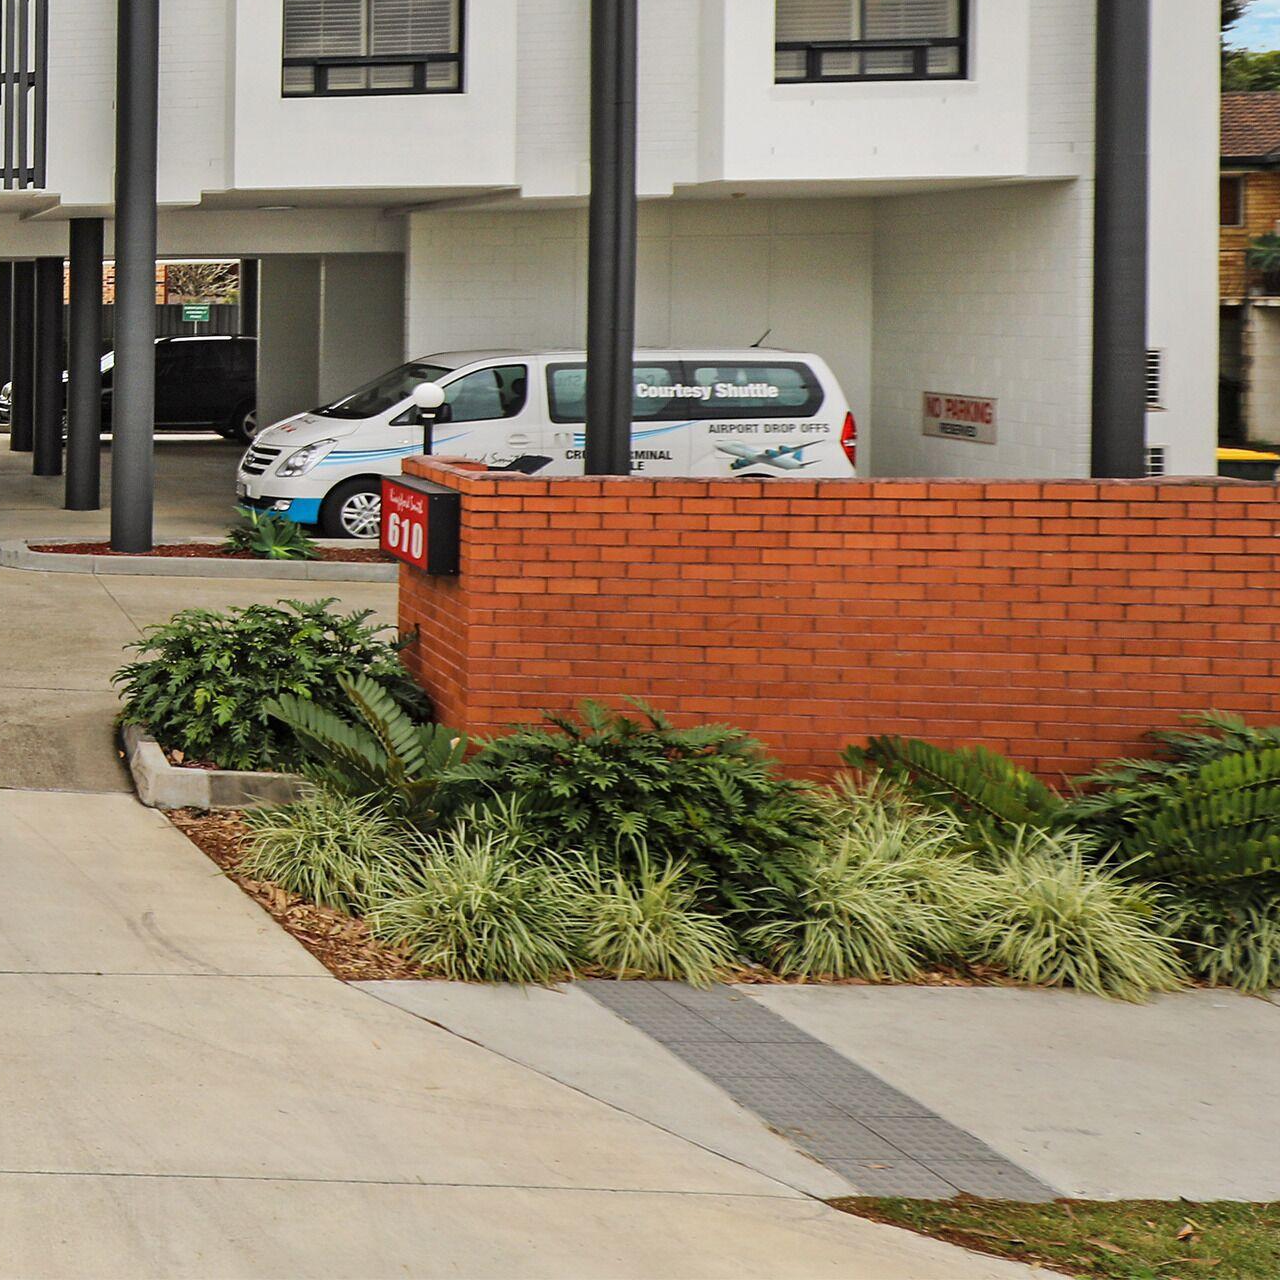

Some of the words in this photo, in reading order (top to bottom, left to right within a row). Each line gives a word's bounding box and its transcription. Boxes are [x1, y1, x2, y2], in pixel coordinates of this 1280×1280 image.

[635, 382, 713, 401] Courtesy
[715, 382, 779, 399] Shuttle
[945, 398, 993, 425] PARKING
[708, 424, 759, 434] AIRPORT
[763, 424, 797, 434] DROP
[801, 423, 831, 434] OFFS
[630, 450, 673, 460] MINAL
[387, 512, 424, 560] 610
